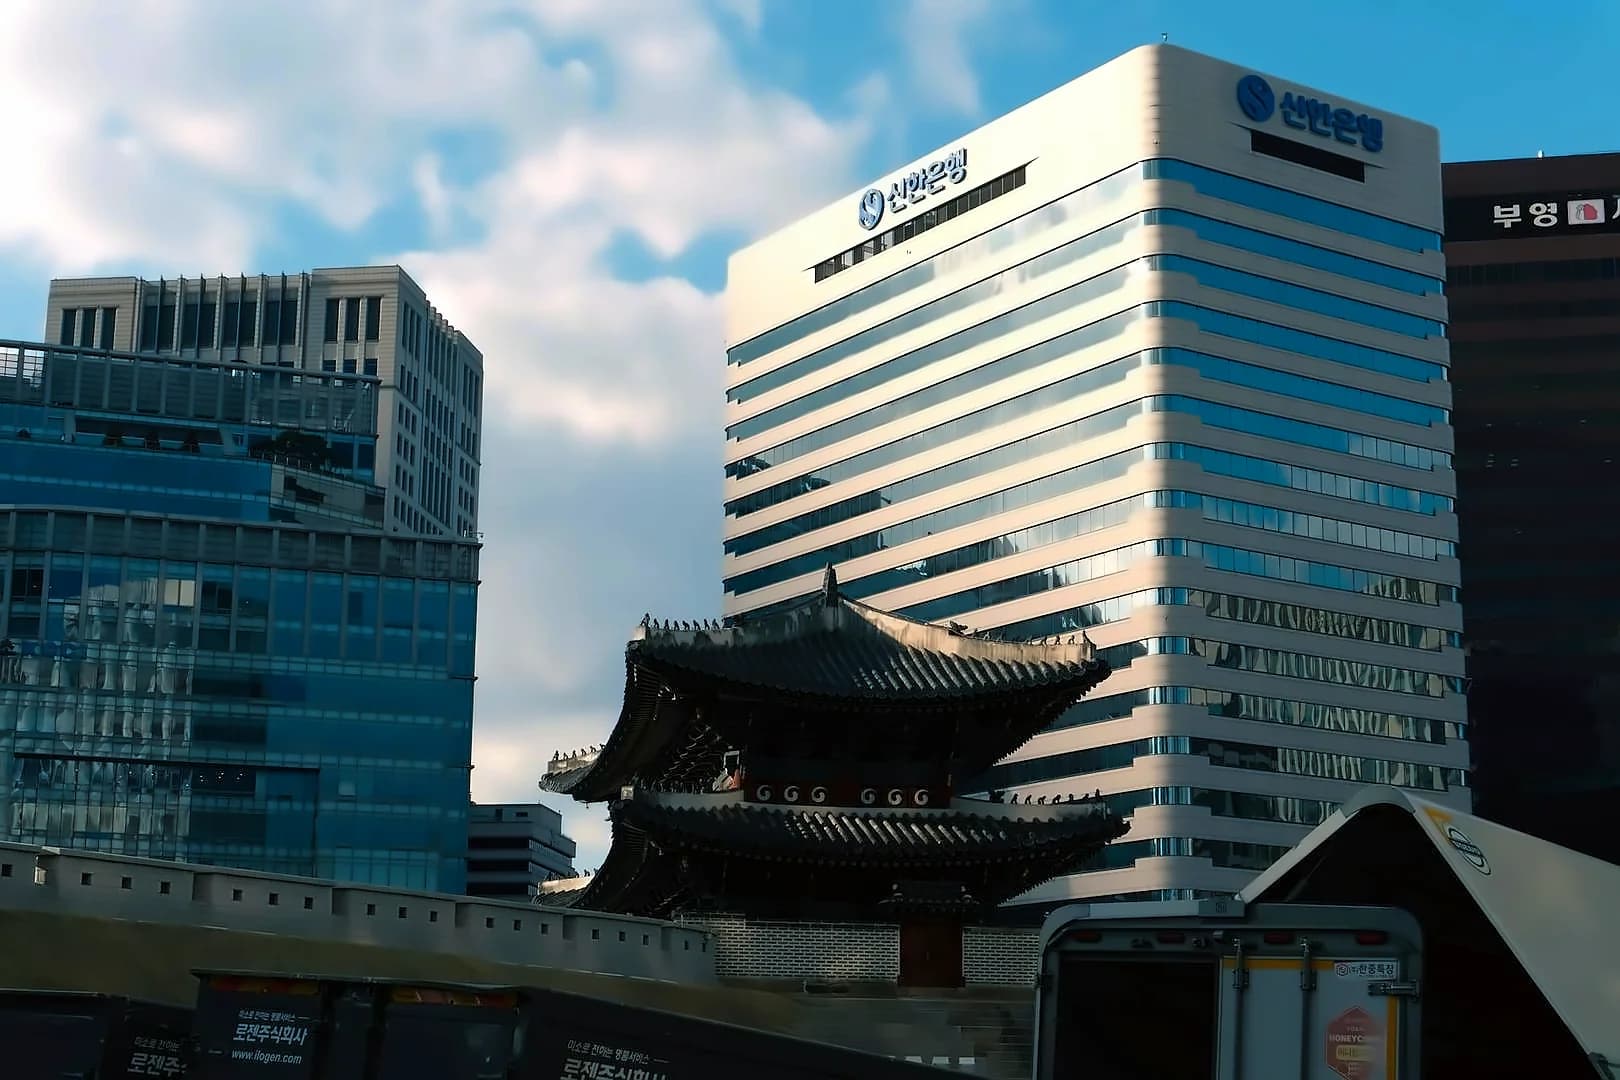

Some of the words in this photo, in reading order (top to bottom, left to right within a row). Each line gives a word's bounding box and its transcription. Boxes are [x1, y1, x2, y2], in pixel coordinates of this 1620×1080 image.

[1279, 91, 1384, 153] 신한은행
[886, 148, 968, 213] 신한은행
[1493, 202, 1558, 228] 부영
[232, 1023, 308, 1046] 로젠주식회사
[128, 1052, 188, 1077] 로젠주
[232, 1049, 302, 1064] www.ilogen.com
